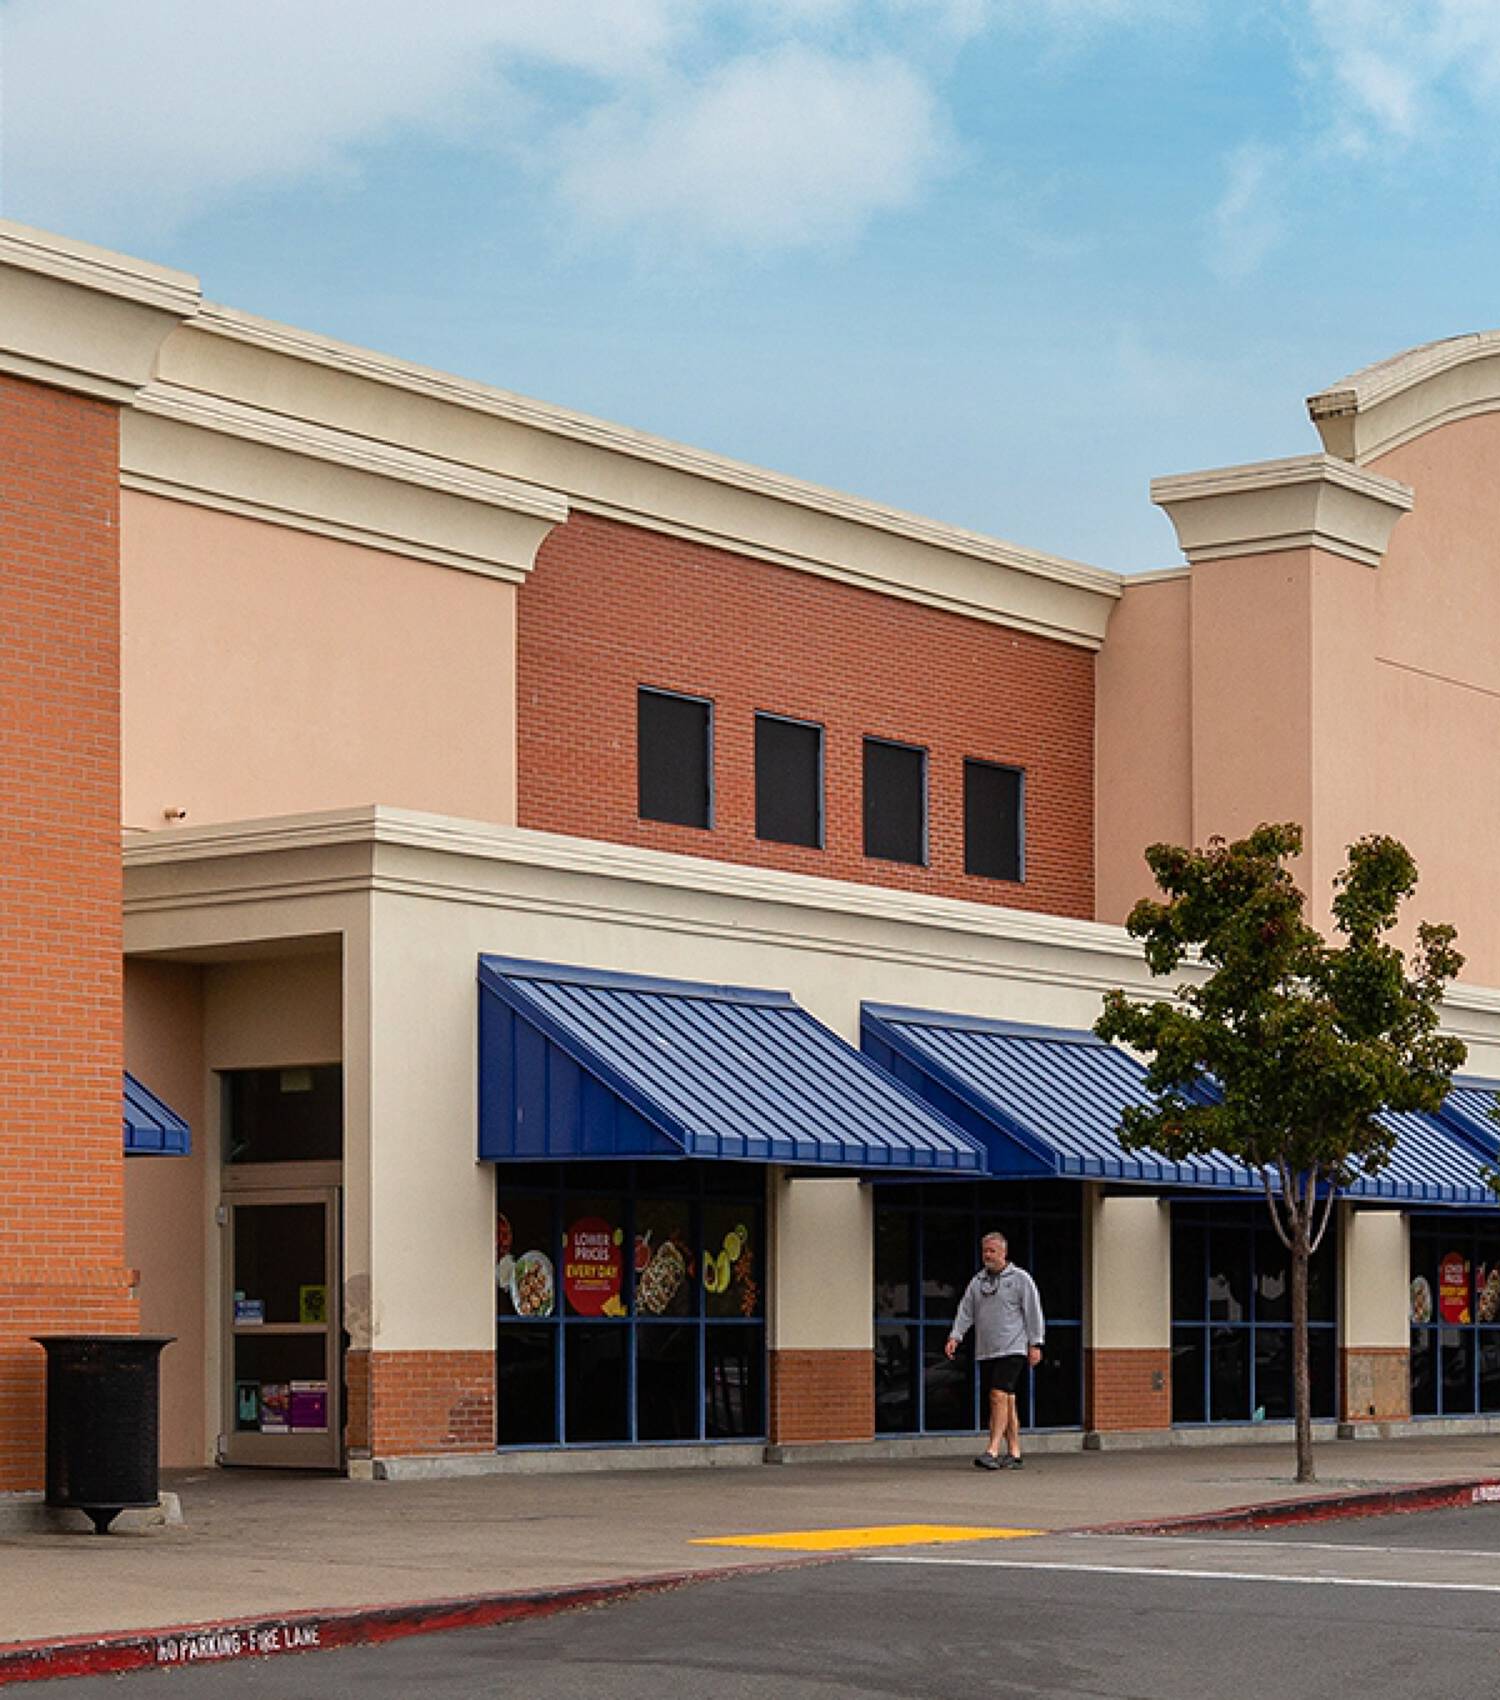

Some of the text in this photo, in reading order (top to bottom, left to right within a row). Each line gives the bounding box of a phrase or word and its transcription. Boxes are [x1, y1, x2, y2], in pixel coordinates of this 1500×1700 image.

[574, 1247, 611, 1261] PRICES
[566, 1264, 619, 1278] EVERY DAY
